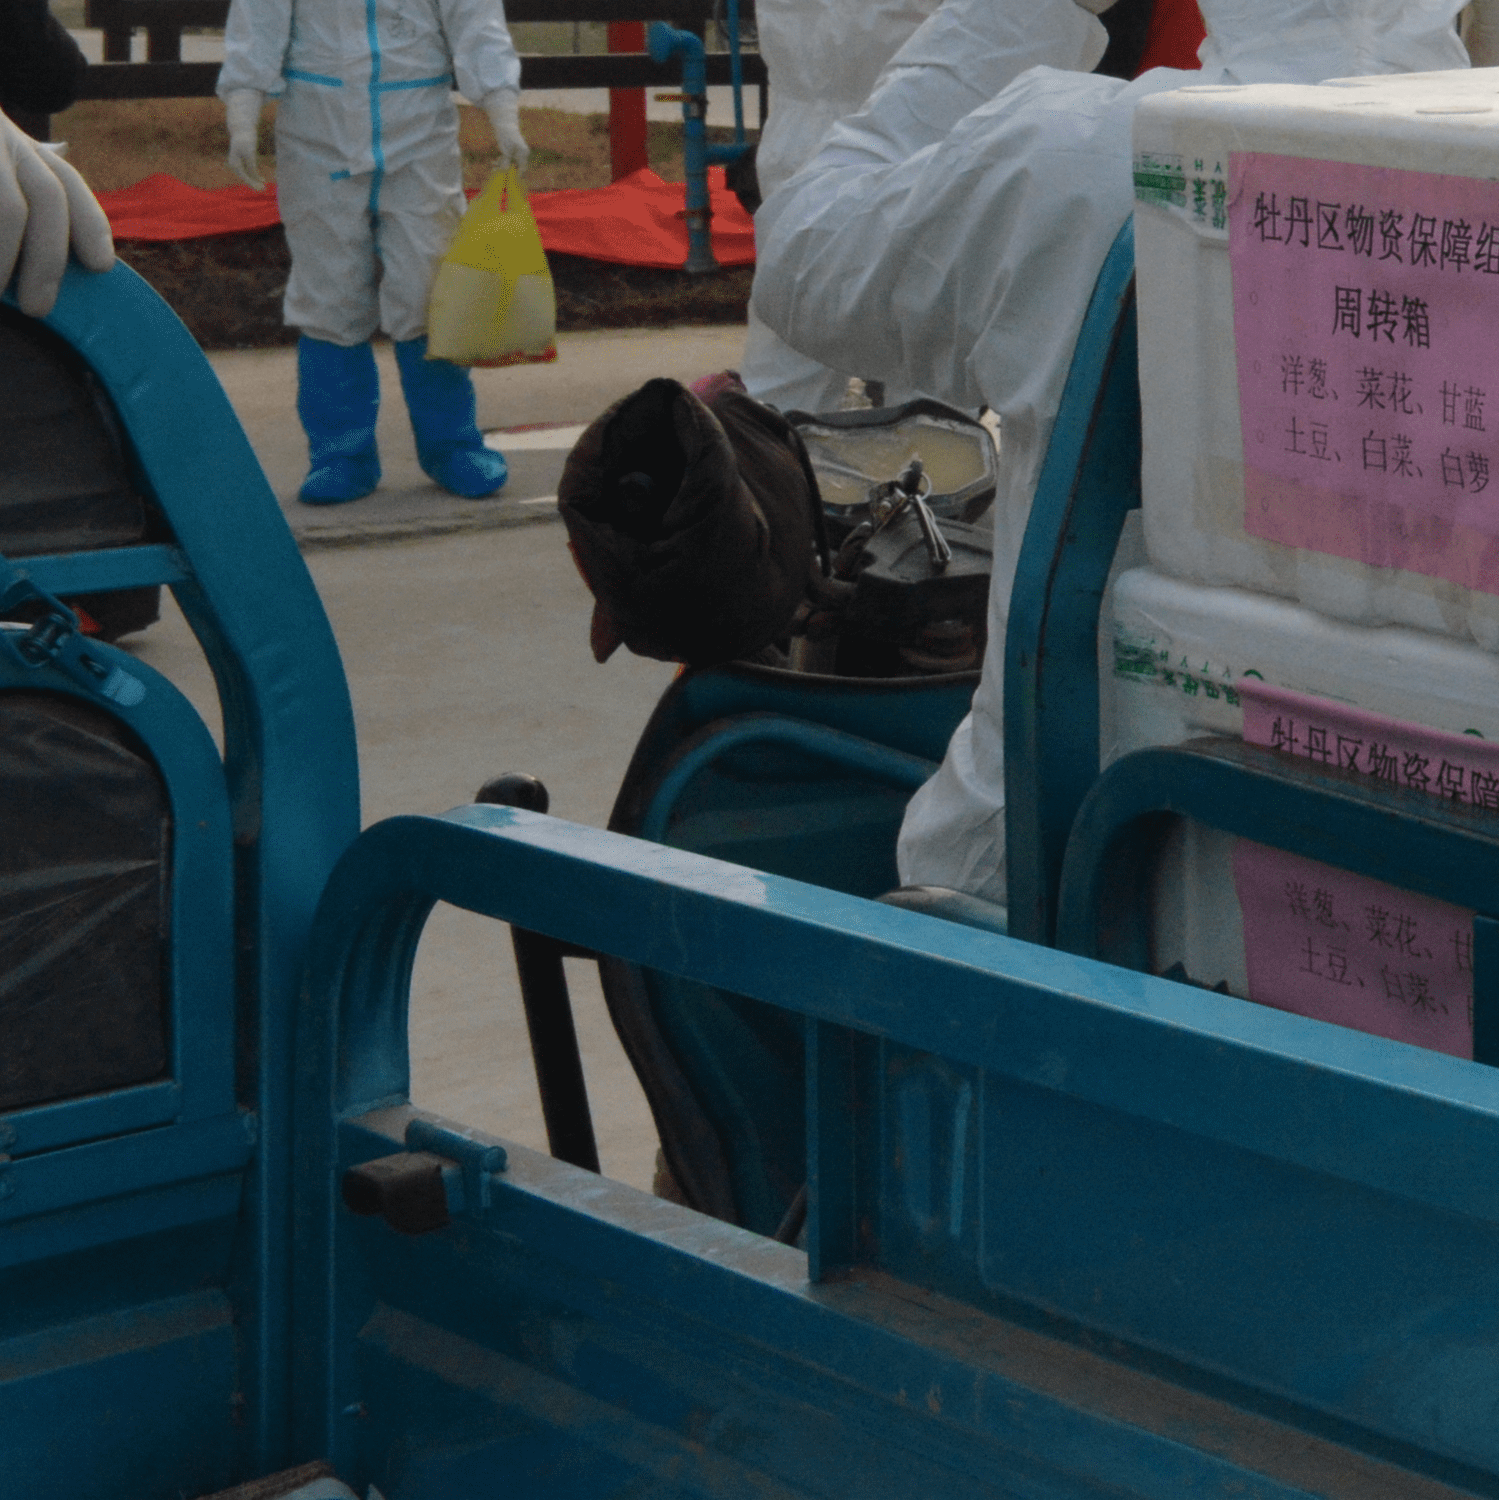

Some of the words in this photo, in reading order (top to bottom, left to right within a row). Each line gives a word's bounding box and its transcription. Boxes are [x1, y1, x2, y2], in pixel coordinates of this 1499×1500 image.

[1331, 285, 1432, 350] 周转箱
[1280, 354, 1487, 433] 洋葱、菜花、甘蓝
[1284, 881, 1473, 973] 洋葱、菜花、甘
